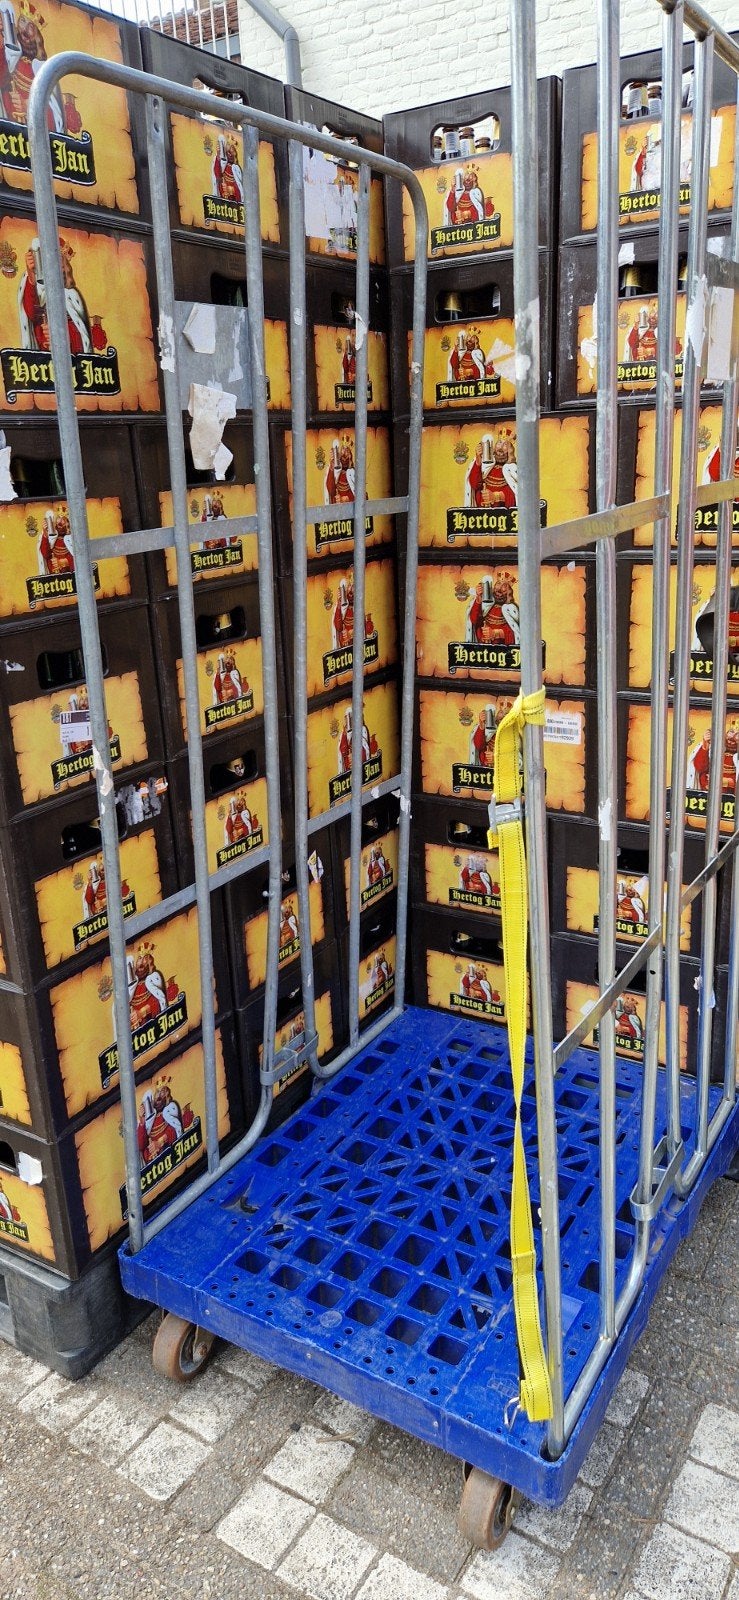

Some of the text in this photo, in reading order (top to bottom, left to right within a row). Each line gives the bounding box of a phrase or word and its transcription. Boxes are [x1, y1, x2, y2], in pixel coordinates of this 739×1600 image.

[53, 139, 90, 175] Jan
[206, 199, 238, 222] Hertog
[620, 193, 660, 213] Herto
[435, 223, 498, 246] Hertog Jan
[81, 360, 115, 389] Jan
[440, 381, 498, 399] Hertog Jan
[319, 520, 352, 540] Hertog
[453, 511, 508, 532] Hertog
[194, 549, 241, 569] Hertog Jan
[31, 578, 74, 598] Hertog
[326, 652, 353, 675] Herto
[454, 644, 507, 667] Hertog
[207, 699, 251, 724] Hertog Jan
[364, 762, 380, 782] Jan
[458, 767, 494, 786] Hert
[219, 834, 261, 864] Hertog Jan
[453, 889, 483, 906] Hertog
[77, 916, 107, 941] Herto
[636, 924, 649, 935] Ja
[453, 994, 502, 1015] Hertog Jan
[106, 1007, 184, 1074] Htog Jan
[141, 1132, 199, 1191] ertog Jan
